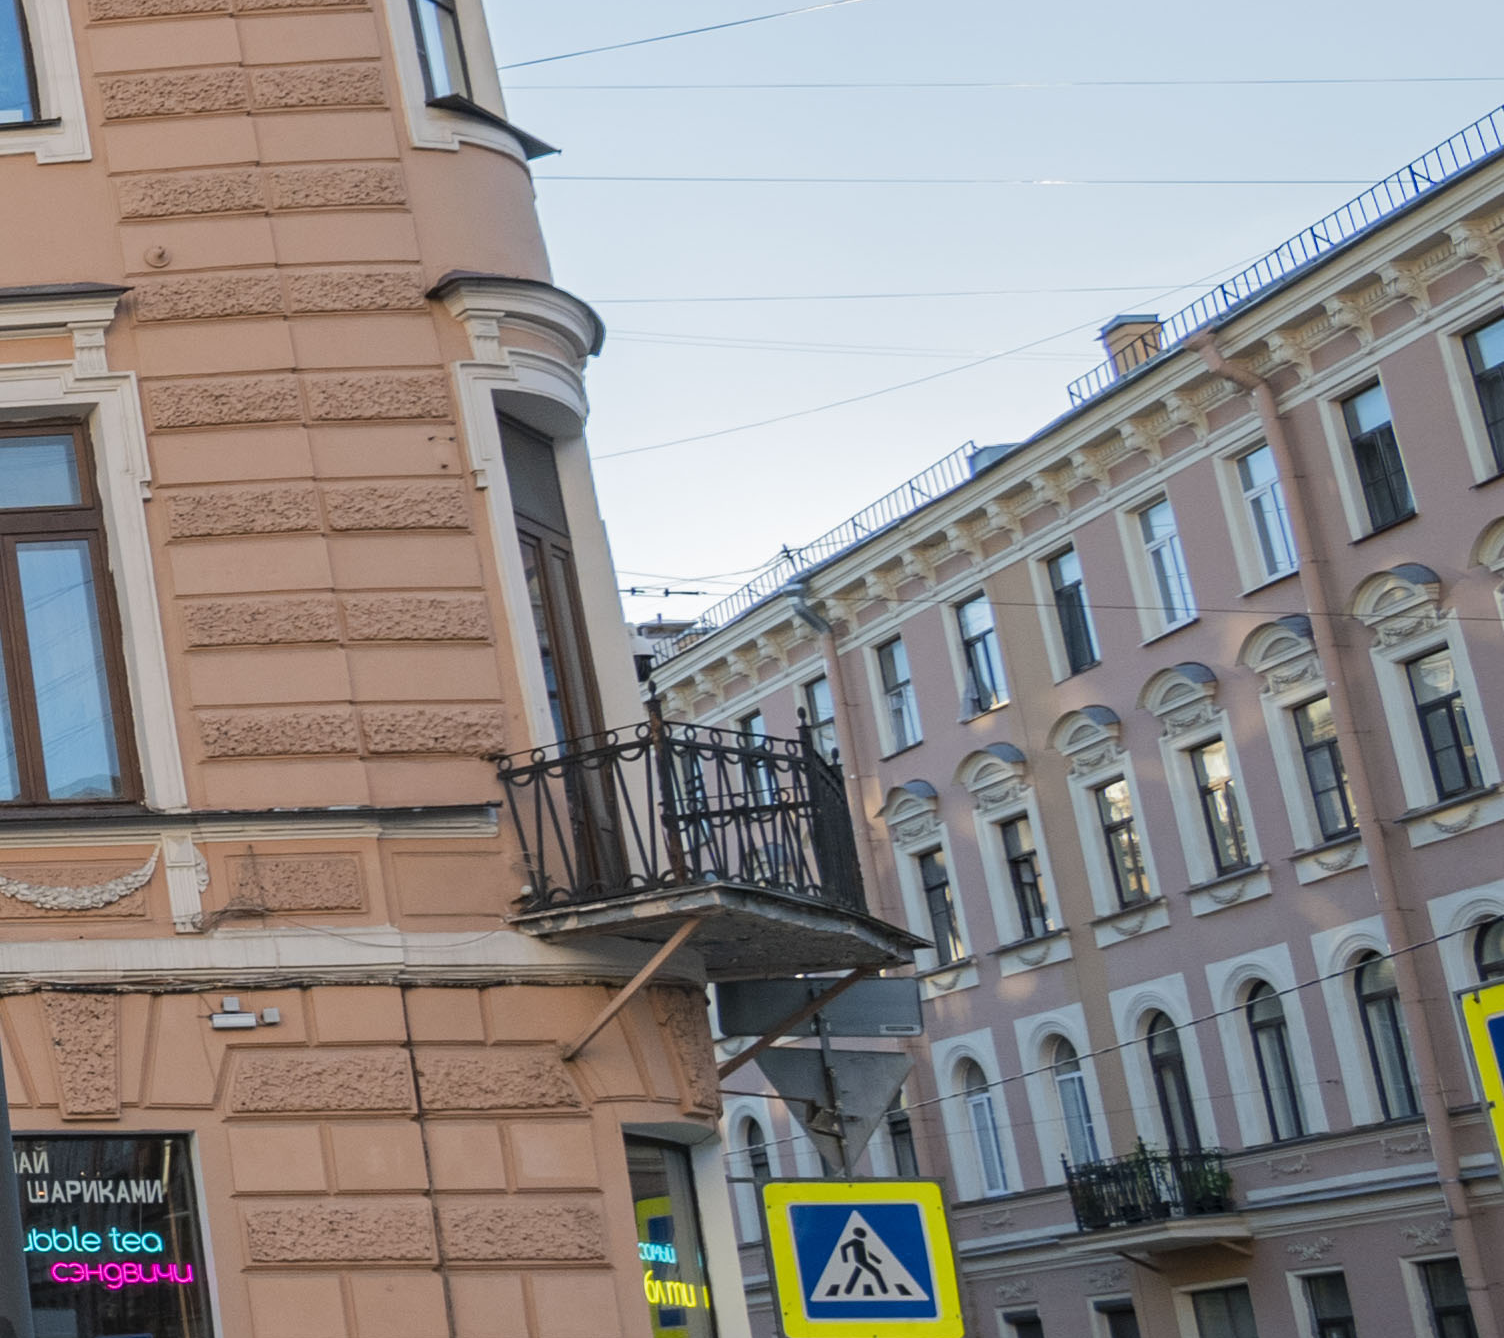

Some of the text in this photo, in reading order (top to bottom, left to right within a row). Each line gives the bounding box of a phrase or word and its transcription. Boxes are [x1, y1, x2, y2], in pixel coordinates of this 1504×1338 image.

[27, 1180, 164, 1203] ШАРИКАМИ
[108, 1226, 163, 1253] tea
[51, 1261, 194, 1289] сэндвичи
